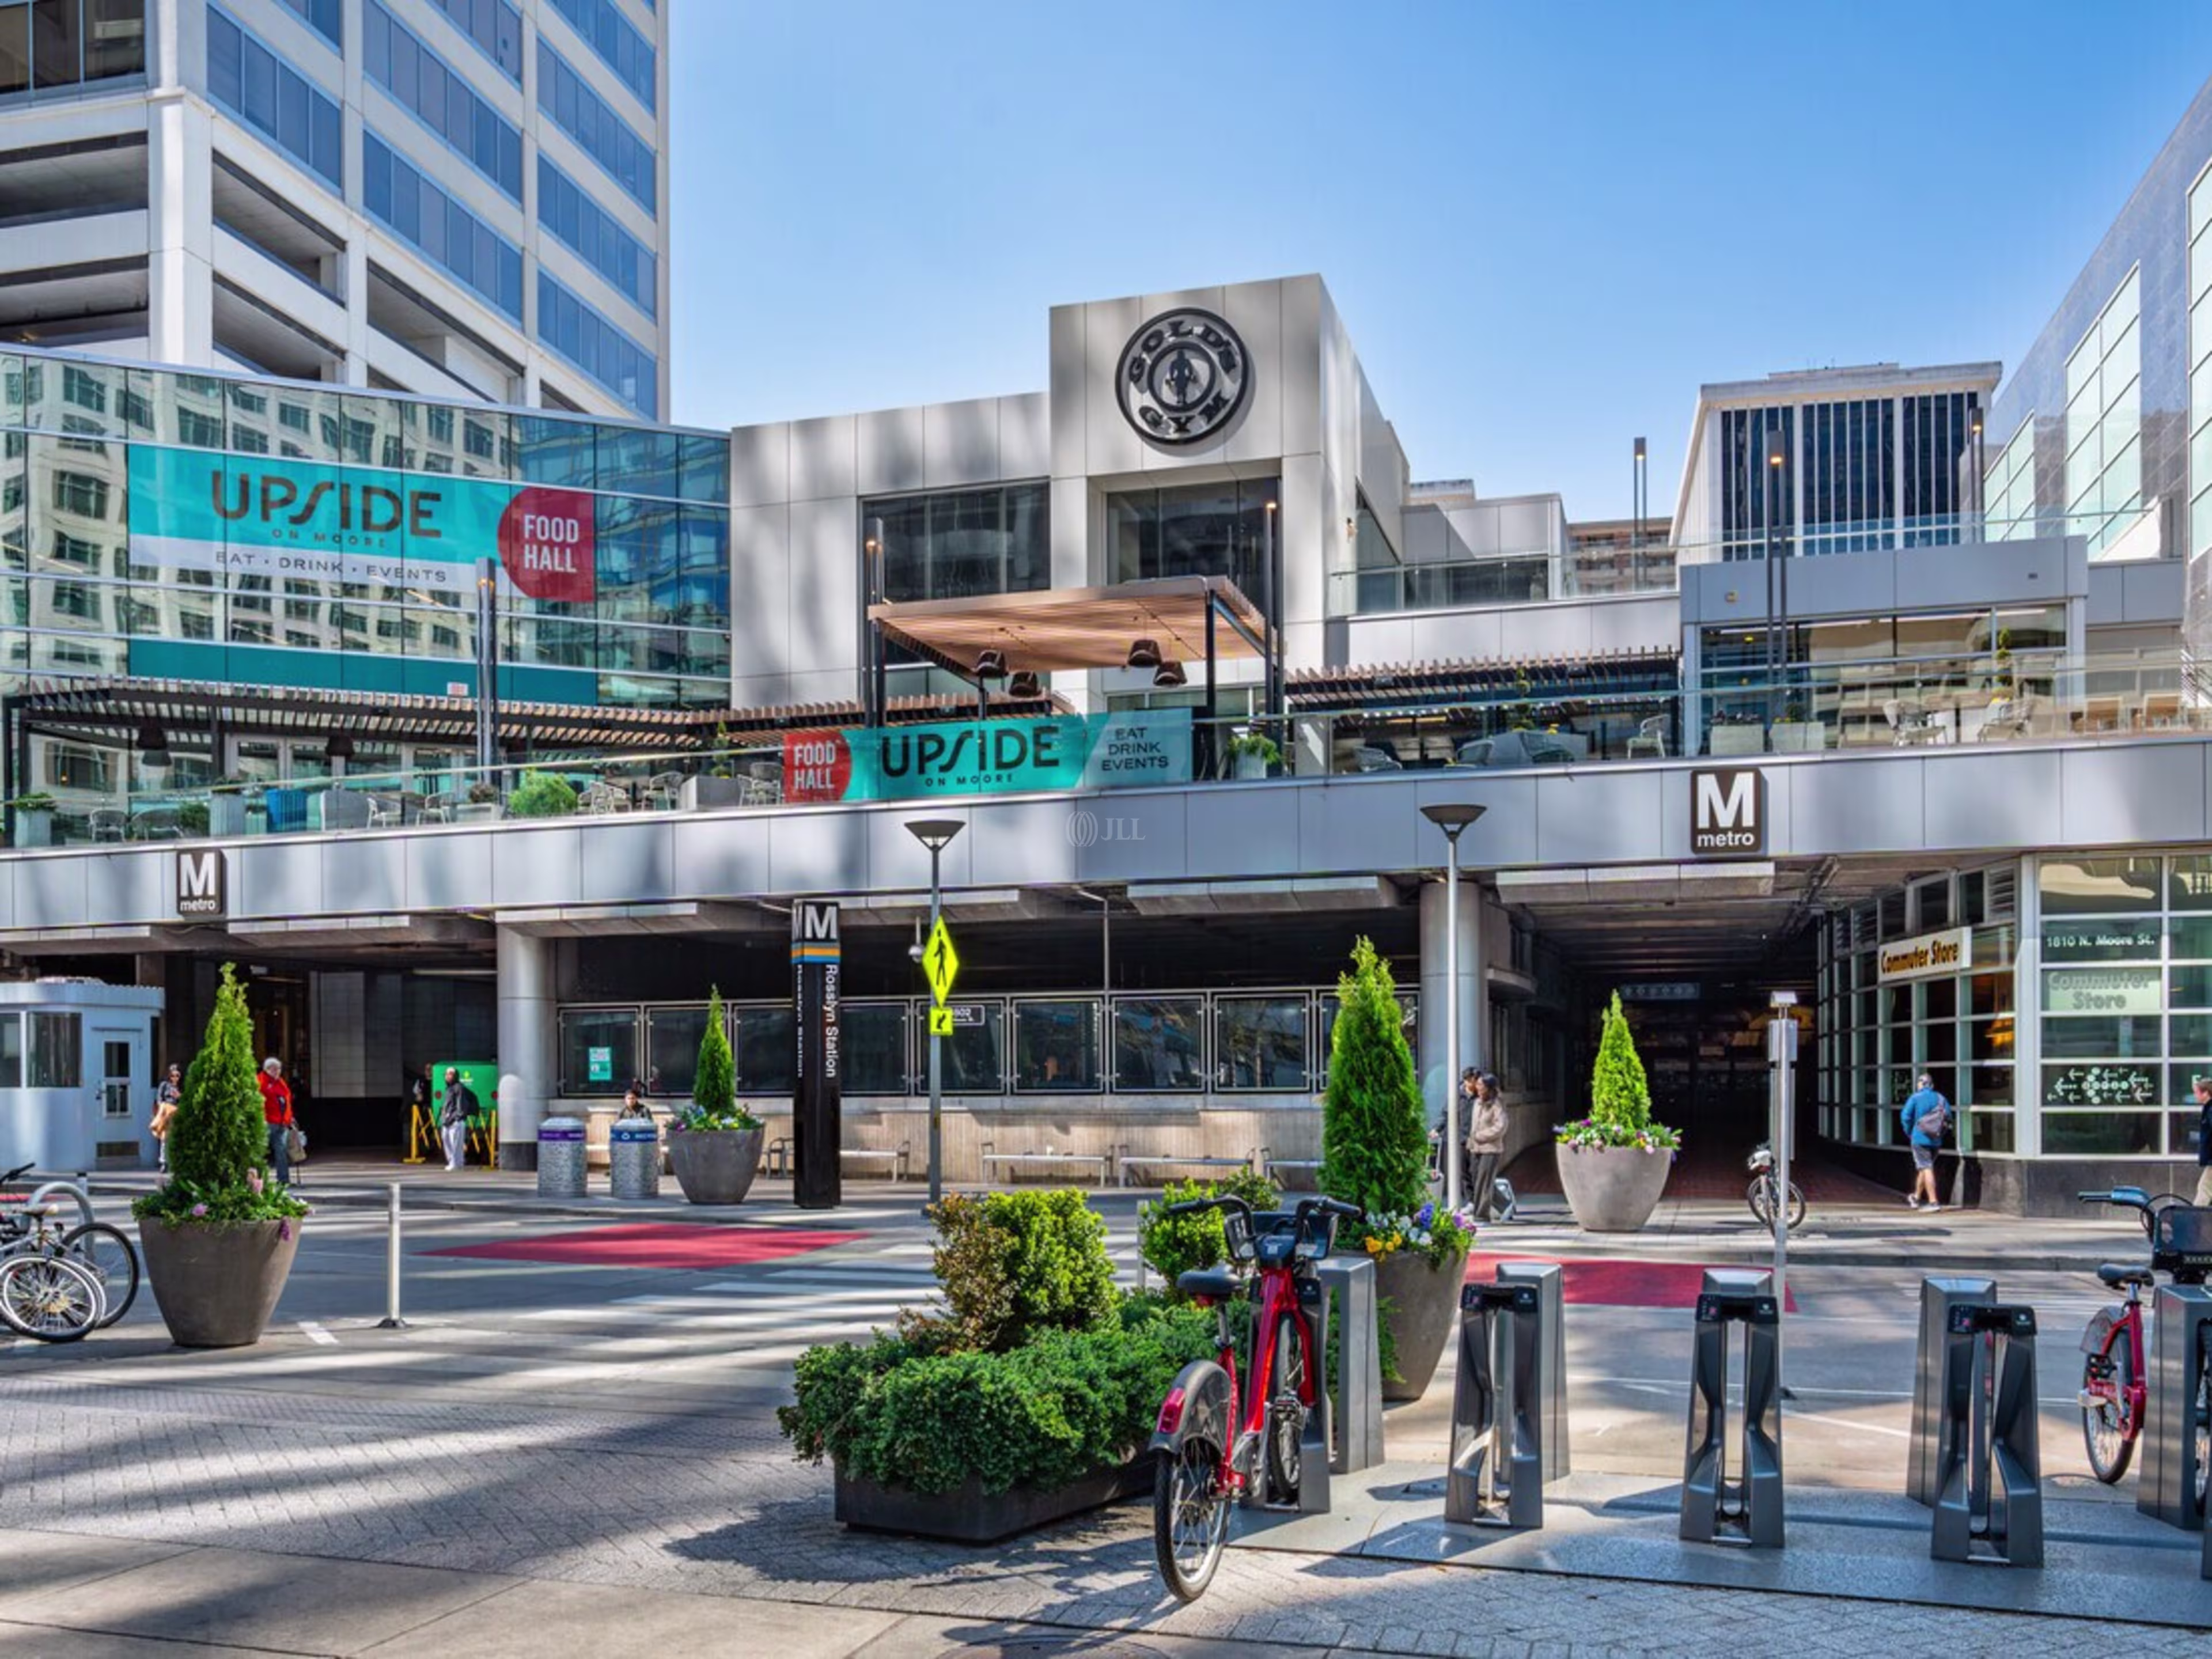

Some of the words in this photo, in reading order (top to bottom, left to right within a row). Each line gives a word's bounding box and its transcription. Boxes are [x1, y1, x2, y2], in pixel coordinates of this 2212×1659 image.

[1139, 390, 1230, 433] GYM
[212, 470, 442, 538] UPSIDE
[272, 529, 298, 540] ON
[315, 532, 386, 547] MOORE
[524, 514, 579, 543] FOOD
[216, 551, 255, 566] EAT
[279, 556, 343, 573] DRINK
[366, 565, 446, 583] EVENTS
[524, 544, 577, 573] HALL
[1115, 727, 1147, 741] EAT
[794, 741, 836, 766] FOOD
[882, 726, 1060, 778] UPSIDE
[1108, 741, 1161, 756] DRINK
[1101, 756, 1169, 771] EVENTS
[794, 768, 835, 791] HALL
[926, 778, 946, 787] ON
[957, 774, 1013, 785] MOORE
[1698, 771, 1755, 828] M
[1698, 831, 1755, 847] metro
[180, 853, 215, 897] M
[180, 899, 215, 911] metro
[805, 904, 838, 940] M
[2095, 934, 2134, 946] Moore
[1881, 945, 1930, 974] Commuter
[1931, 940, 1958, 965] Store
[823, 964, 838, 1022] Rosslyn
[2048, 971, 2149, 991] Commuter
[2073, 991, 2127, 1009] Store
[826, 1026, 839, 1078] Station
